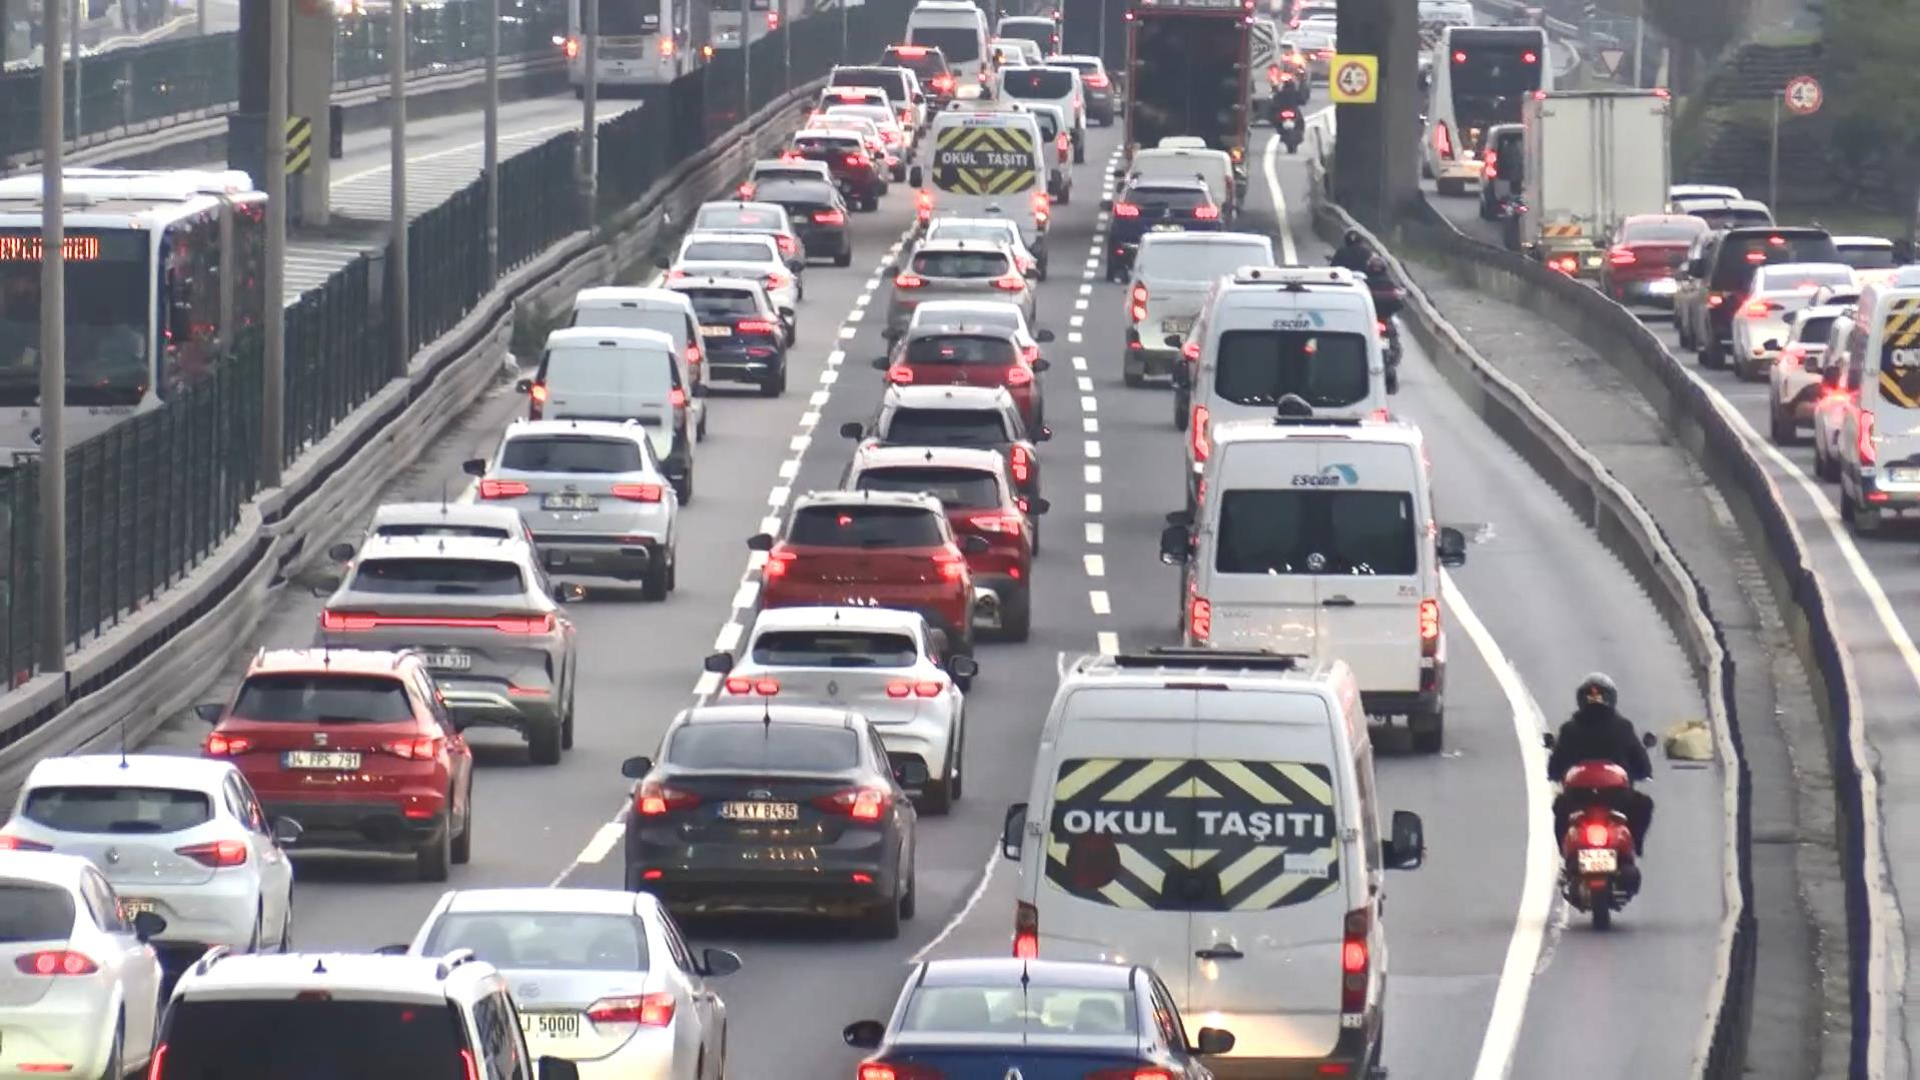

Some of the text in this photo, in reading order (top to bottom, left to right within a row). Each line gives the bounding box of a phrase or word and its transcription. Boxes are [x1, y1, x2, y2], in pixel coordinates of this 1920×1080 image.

[942, 151, 977, 164] OKUL
[723, 802, 738, 816] 34
[764, 804, 796, 818] 8435
[1063, 810, 1324, 842] OKUL TAŞITI
[539, 1016, 575, 1032] 5000
